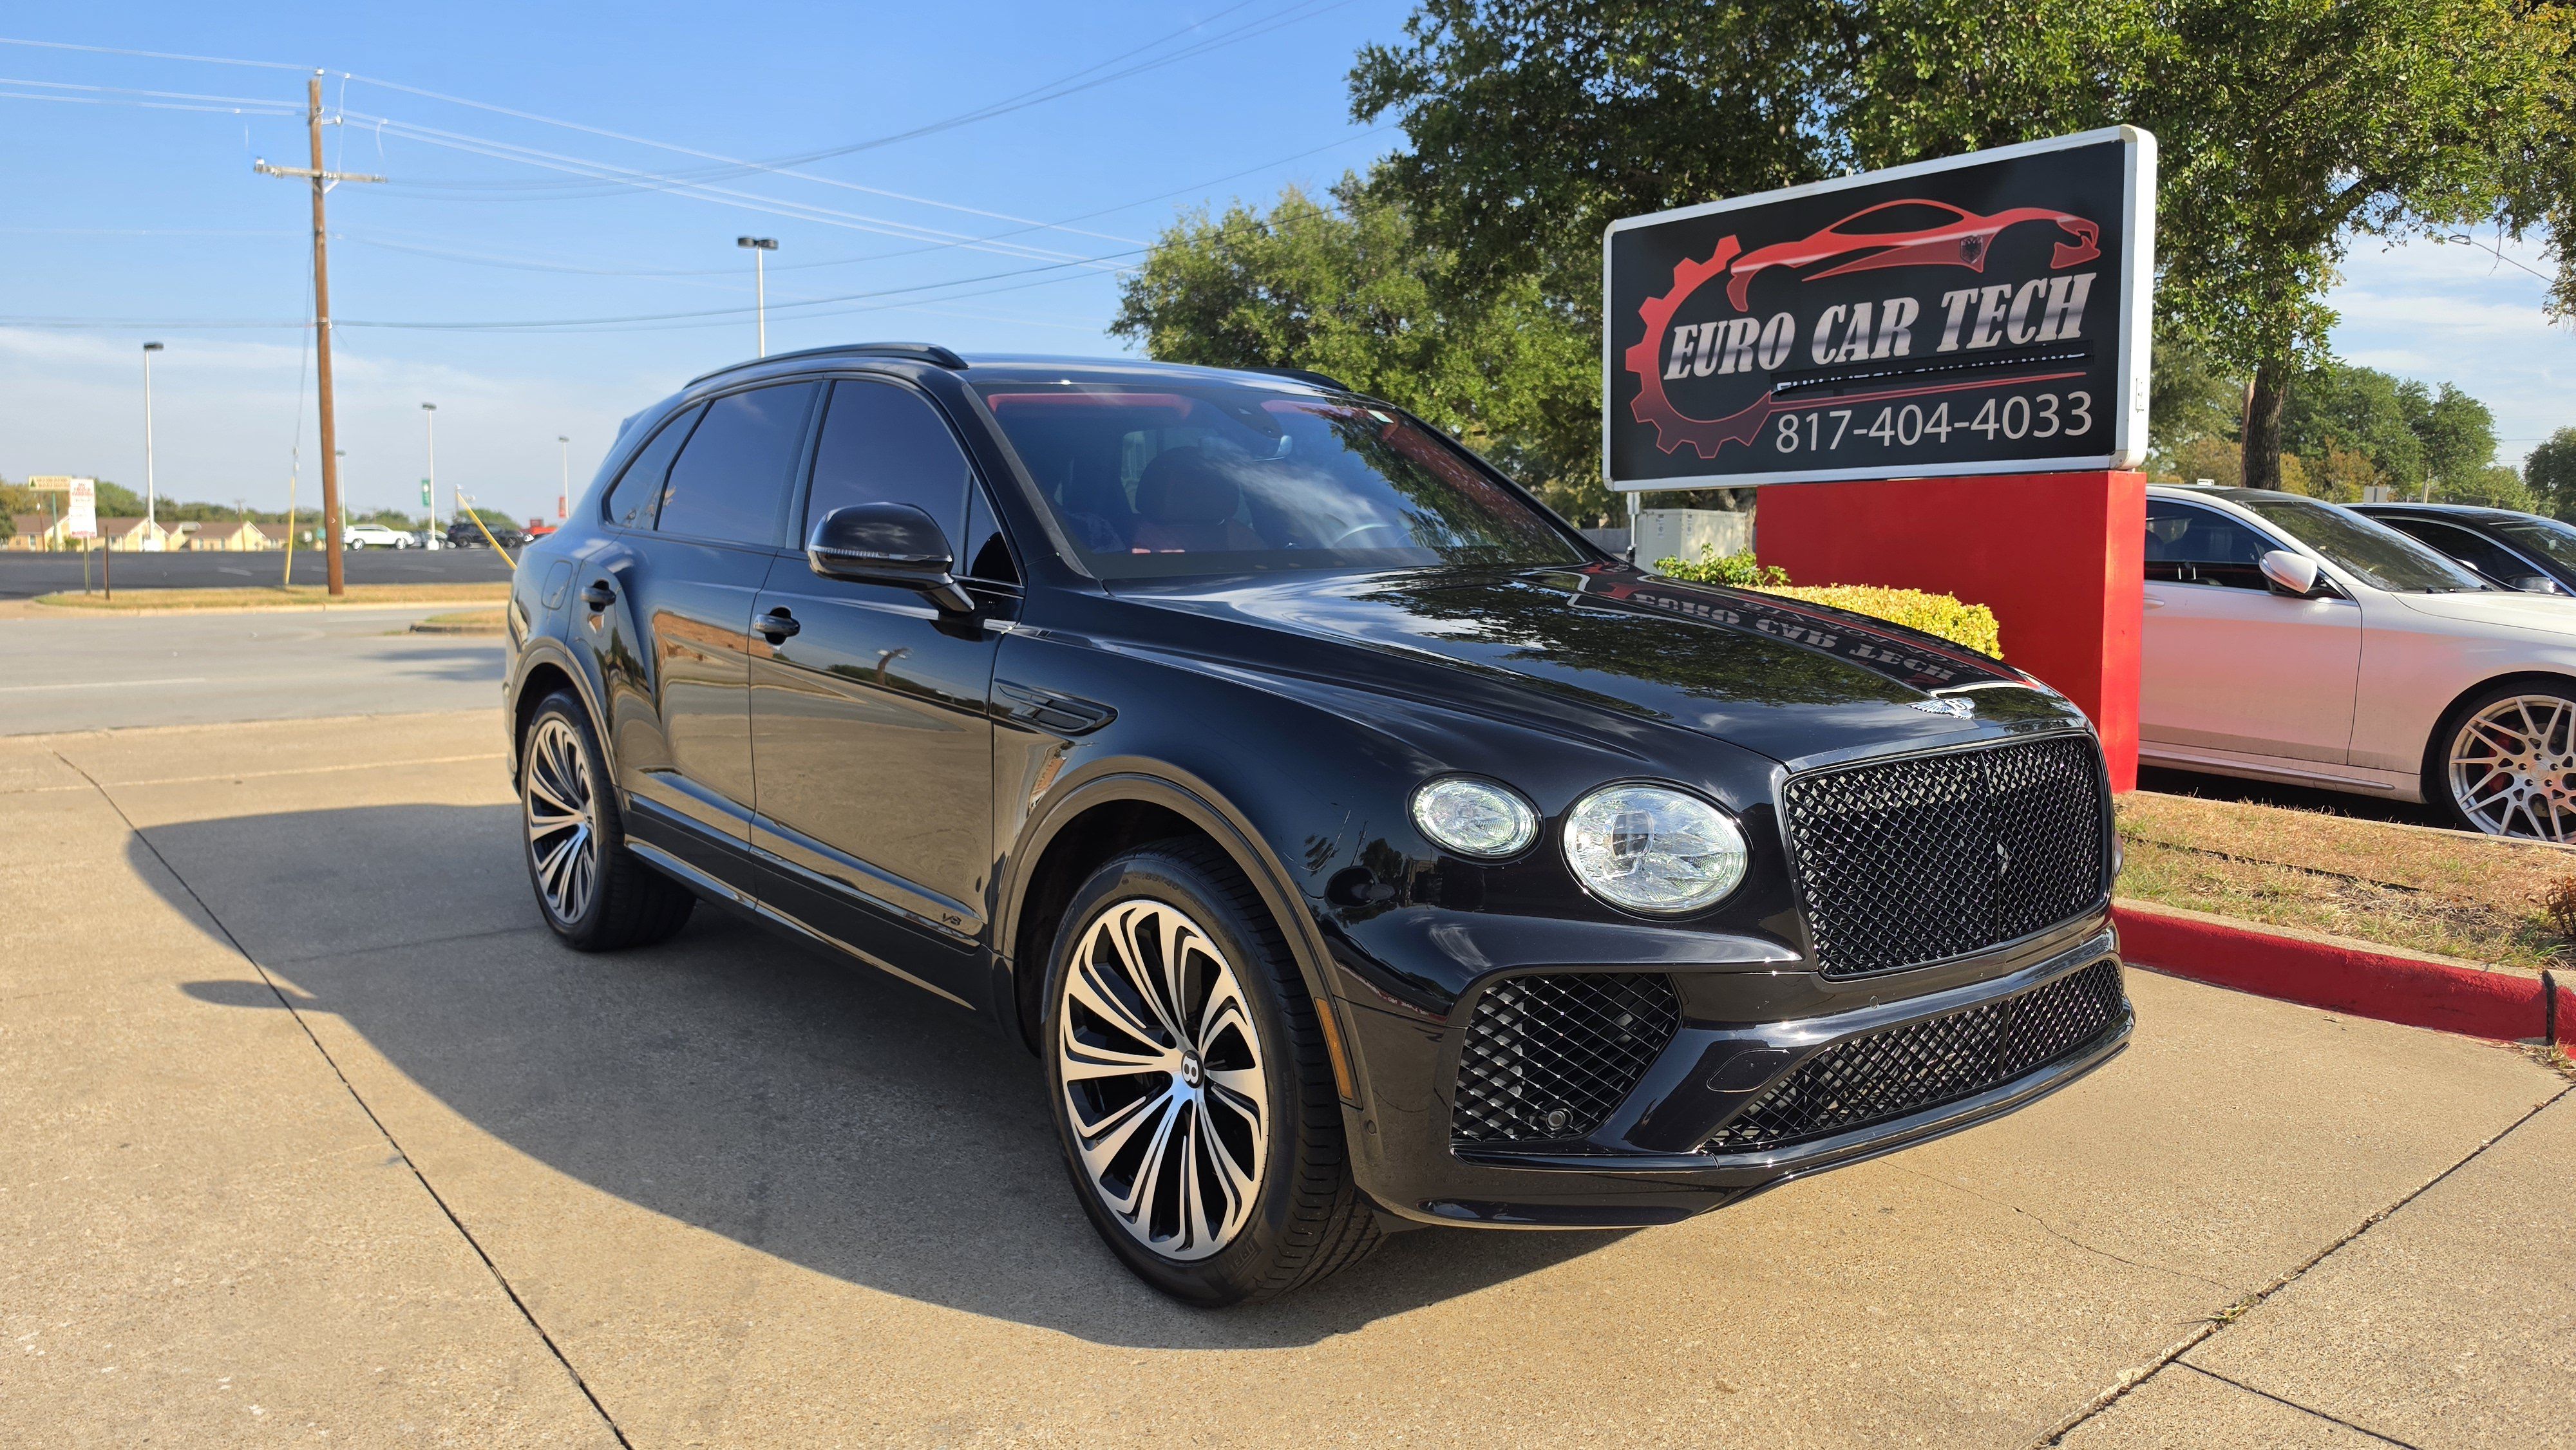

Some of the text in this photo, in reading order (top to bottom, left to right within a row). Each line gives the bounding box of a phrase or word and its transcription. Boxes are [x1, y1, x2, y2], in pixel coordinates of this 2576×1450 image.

[1663, 312, 1795, 381] EURO
[1812, 296, 1920, 365] CAR
[1936, 272, 2097, 352] TECH
[1776, 390, 2093, 453] 817-404-4033
[942, 912, 962, 925] V8
